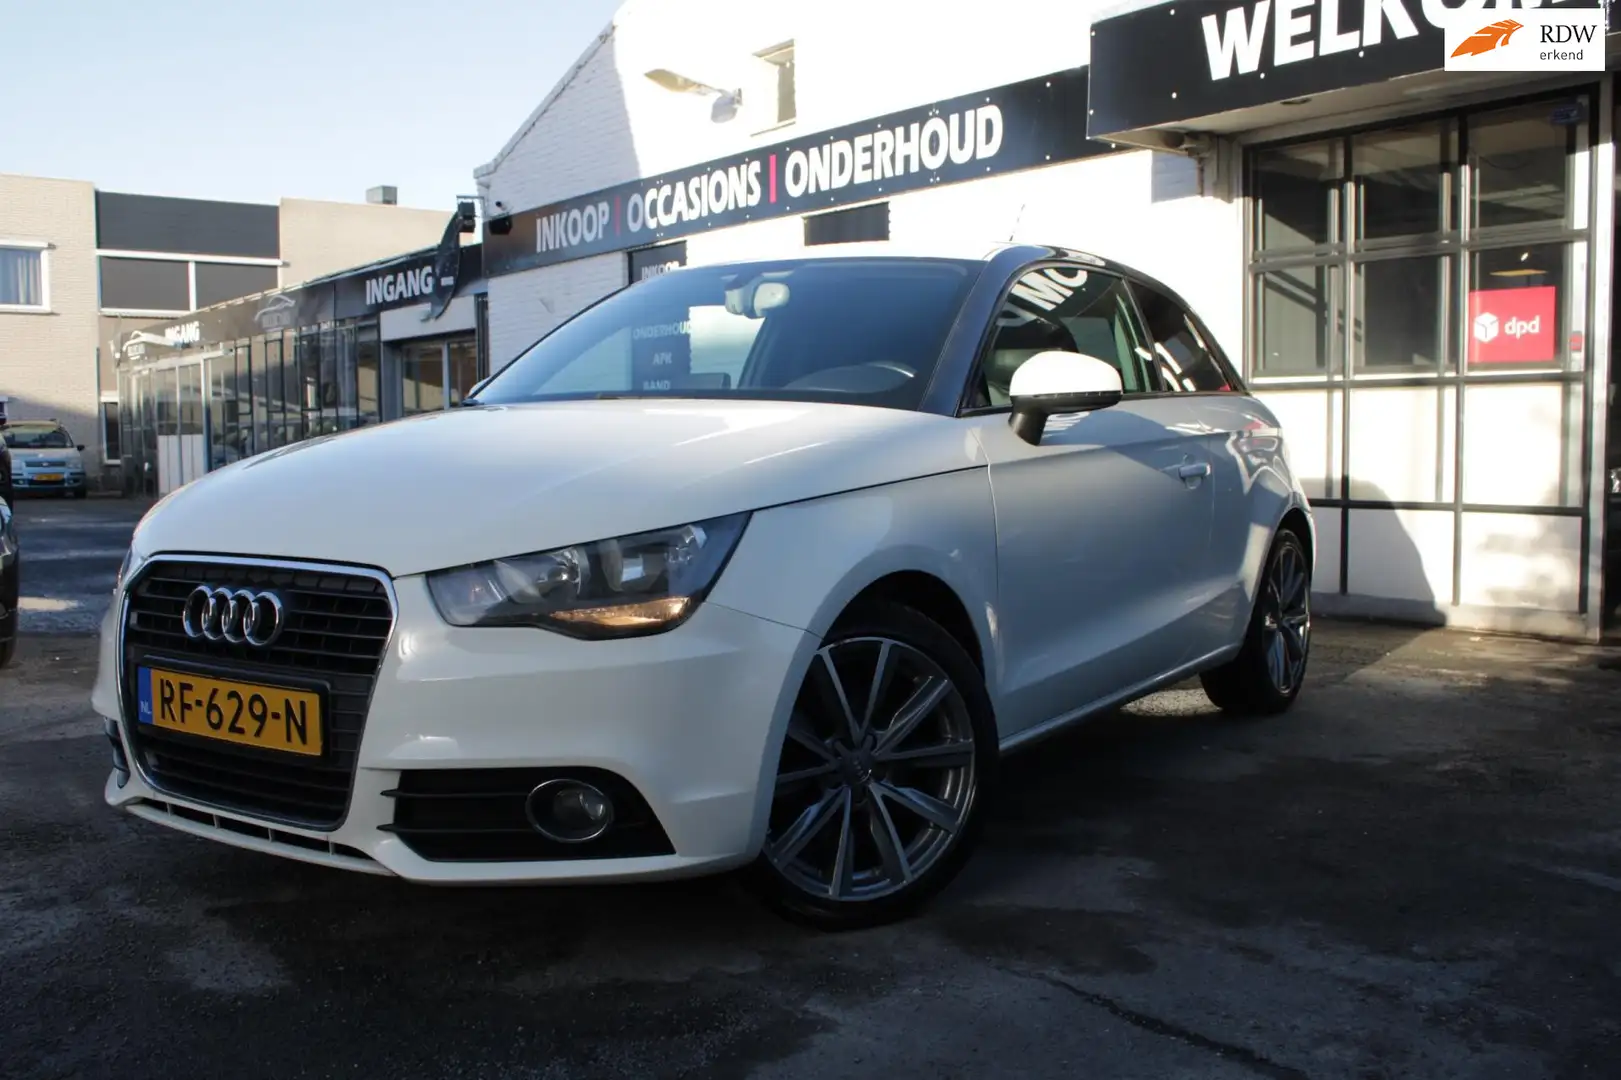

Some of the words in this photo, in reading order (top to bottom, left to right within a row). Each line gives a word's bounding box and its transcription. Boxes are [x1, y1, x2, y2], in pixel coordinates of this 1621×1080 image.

[536, 202, 610, 253] INKOOP
[627, 160, 761, 233] OCCASIONS
[785, 104, 1003, 198] ONDERHOUD
[366, 265, 433, 305] INGANG
[1504, 314, 1541, 340] dpd
[160, 678, 308, 745] RF-629-N
